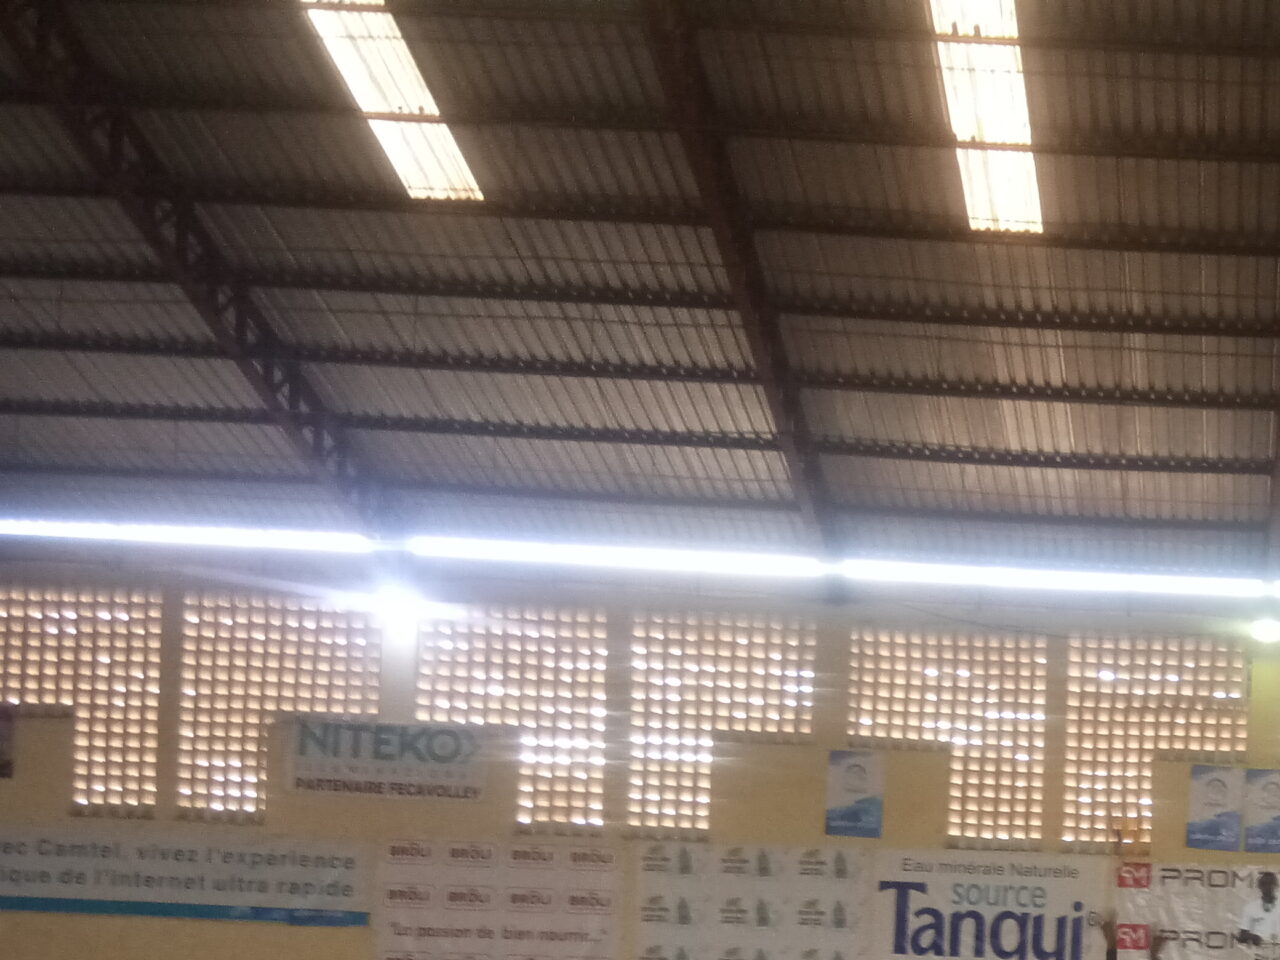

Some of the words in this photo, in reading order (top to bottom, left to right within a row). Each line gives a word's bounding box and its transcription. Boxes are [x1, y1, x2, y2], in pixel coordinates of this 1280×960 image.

[297, 720, 463, 764] NITEKO
[902, 857, 934, 873] Eau
[1010, 862, 1080, 880] Naturelle
[952, 882, 1047, 909] source
